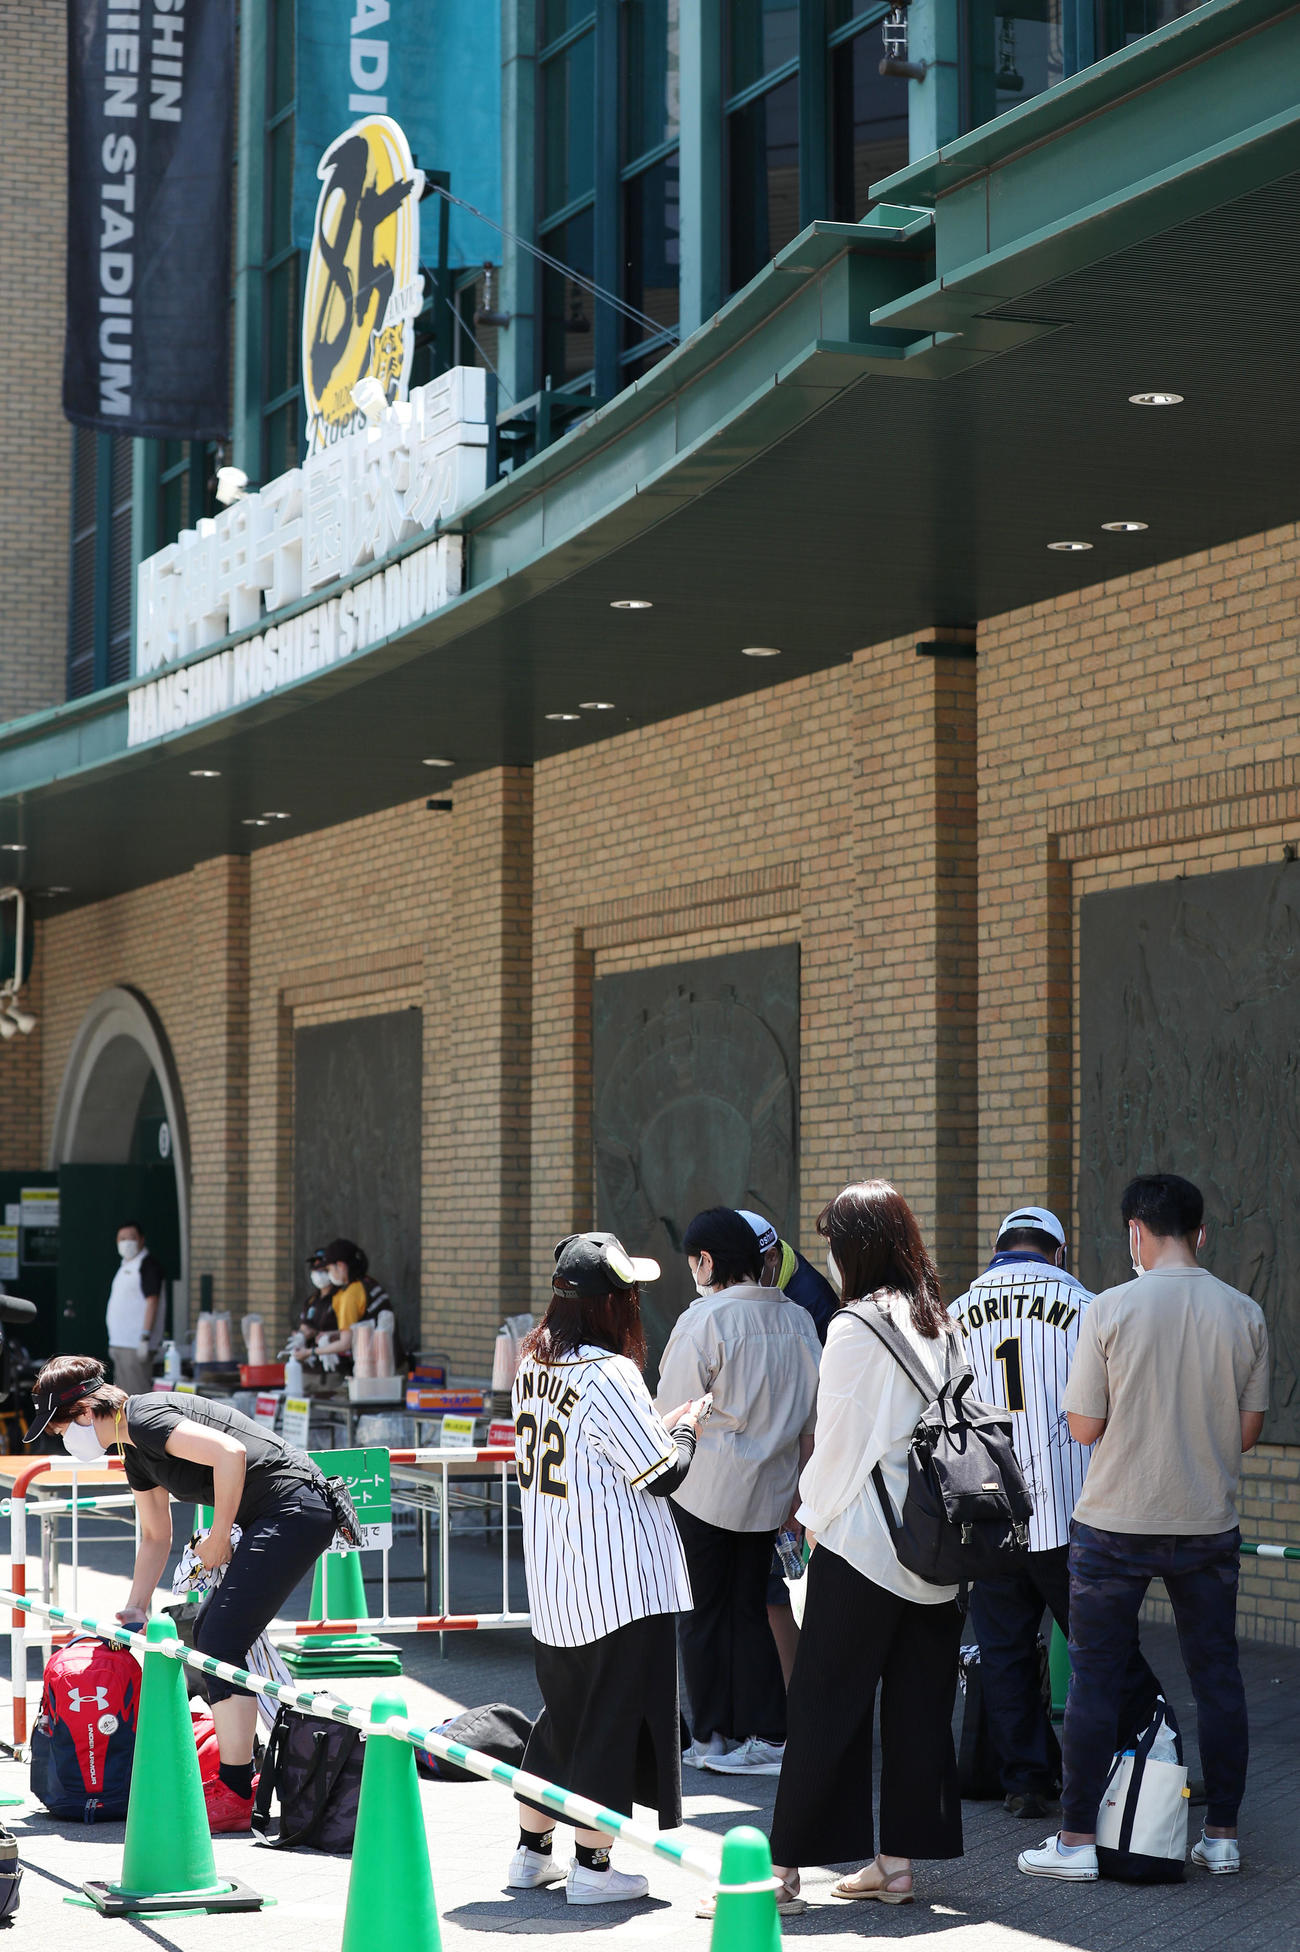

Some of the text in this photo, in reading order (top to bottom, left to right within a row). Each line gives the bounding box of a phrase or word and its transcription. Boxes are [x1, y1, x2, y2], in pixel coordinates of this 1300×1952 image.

[100, 0, 140, 416] IEN STADIUM
[127, 535, 458, 748] HANSHIN KOSHIEN STADIUM
[957, 1294, 1078, 1338] TORITANI
[516, 1370, 580, 1419] INOUE
[994, 1336, 1026, 1413] 1
[515, 1411, 568, 1500] 32
[87, 1723, 97, 1785] UNDER ARMOUR
